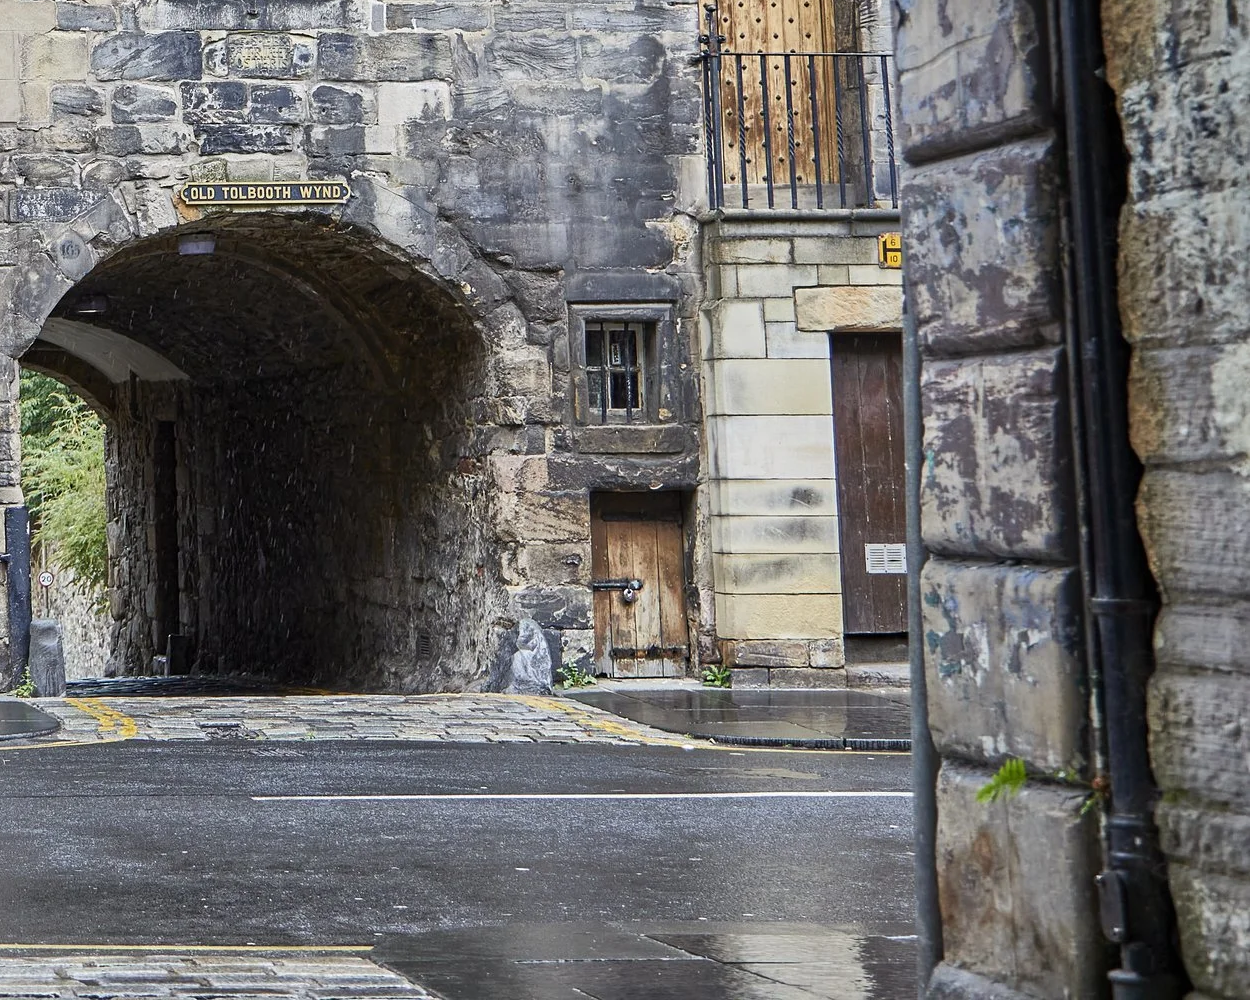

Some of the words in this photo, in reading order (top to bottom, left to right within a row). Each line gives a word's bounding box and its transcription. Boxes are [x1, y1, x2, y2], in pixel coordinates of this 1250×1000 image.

[190, 187, 215, 199] OLD
[222, 186, 291, 199] TOLBOOTH
[300, 185, 341, 198] WYND
[890, 239, 896, 247] 6
[890, 255, 898, 263] 10
